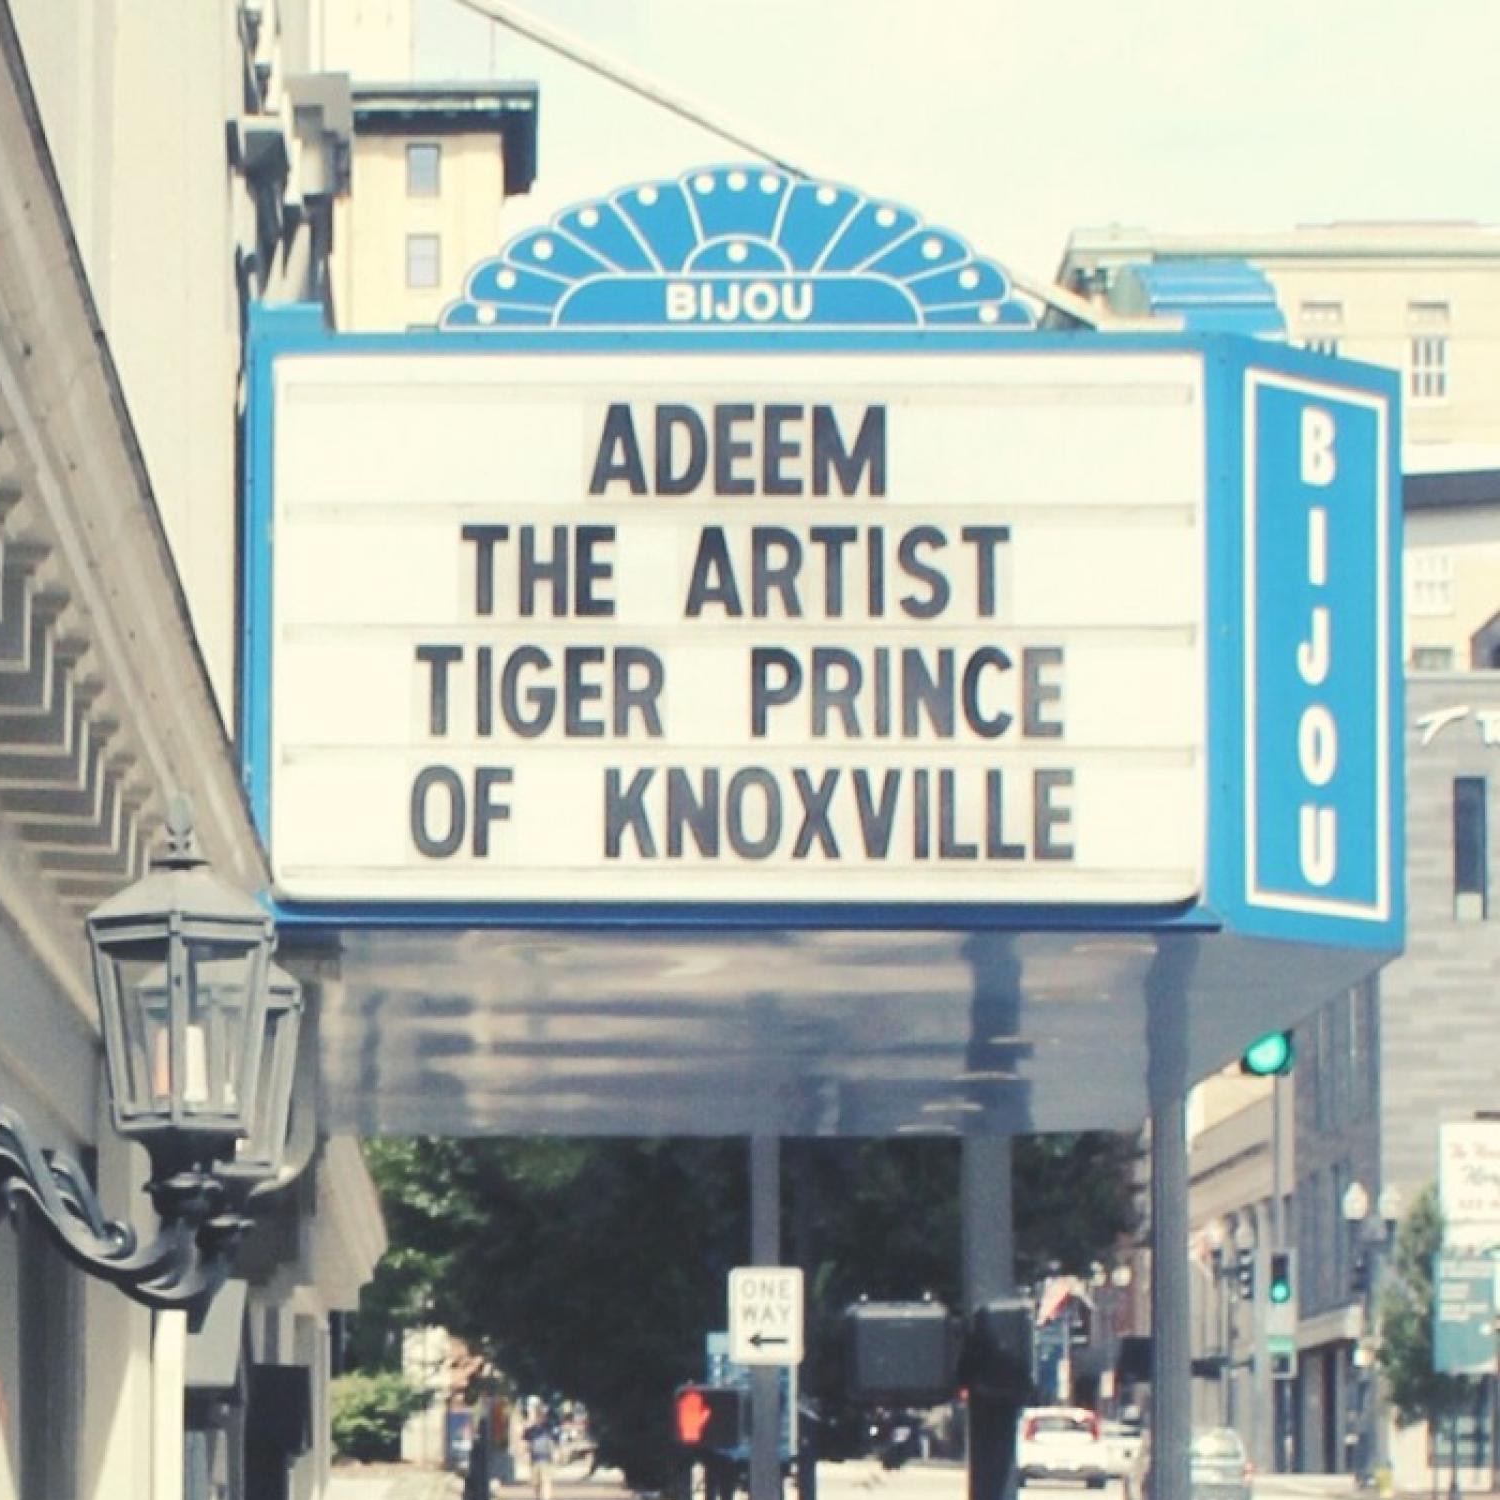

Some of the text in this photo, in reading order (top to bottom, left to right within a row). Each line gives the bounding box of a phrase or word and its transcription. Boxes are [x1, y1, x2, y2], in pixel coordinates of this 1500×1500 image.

[666, 282, 813, 322] BIJOU
[589, 404, 886, 497] ADEEM
[461, 524, 1010, 619] THE ARTIST
[415, 644, 1064, 739] TIGER PRINCE
[1296, 403, 1339, 887] BIJOU
[411, 766, 1073, 861] OF KNOXVILLE
[740, 1278, 791, 1299] ONE
[741, 1304, 792, 1323] WAY
